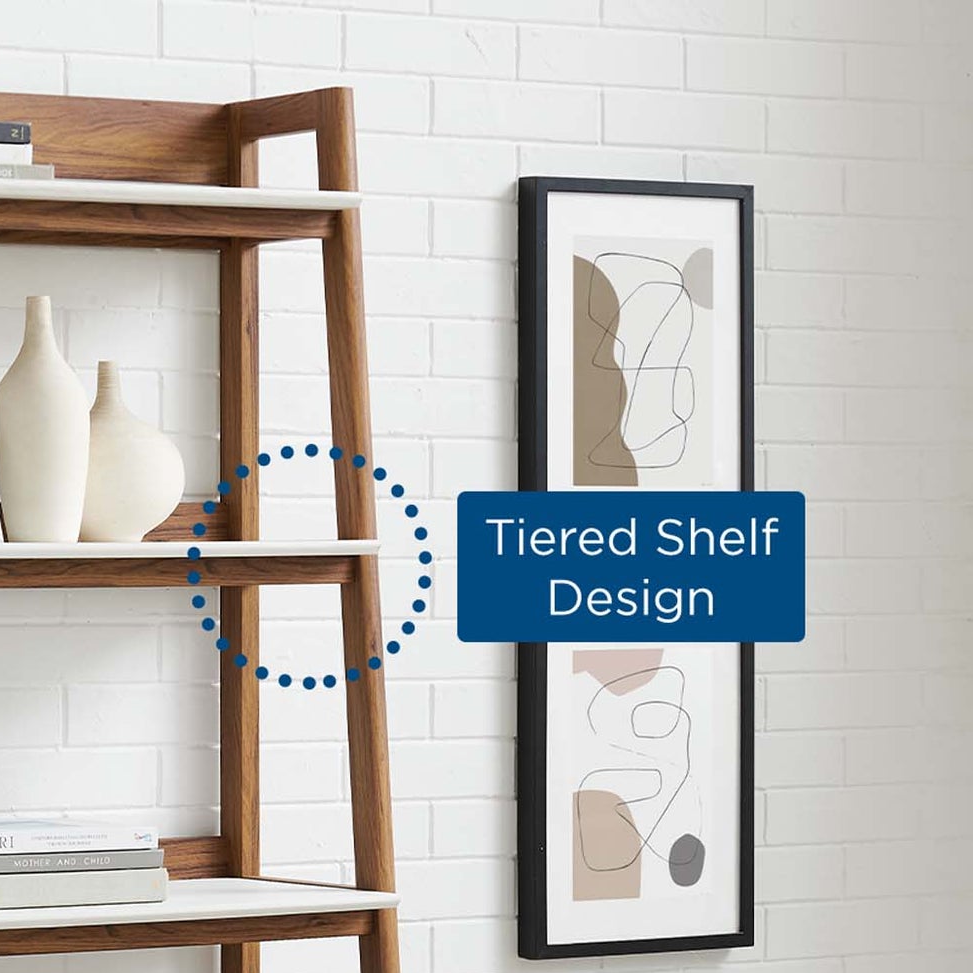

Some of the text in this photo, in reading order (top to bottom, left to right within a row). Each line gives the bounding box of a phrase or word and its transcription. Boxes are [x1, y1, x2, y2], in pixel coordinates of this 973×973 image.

[13, 856, 111, 868] MOTHER AND CHILD
